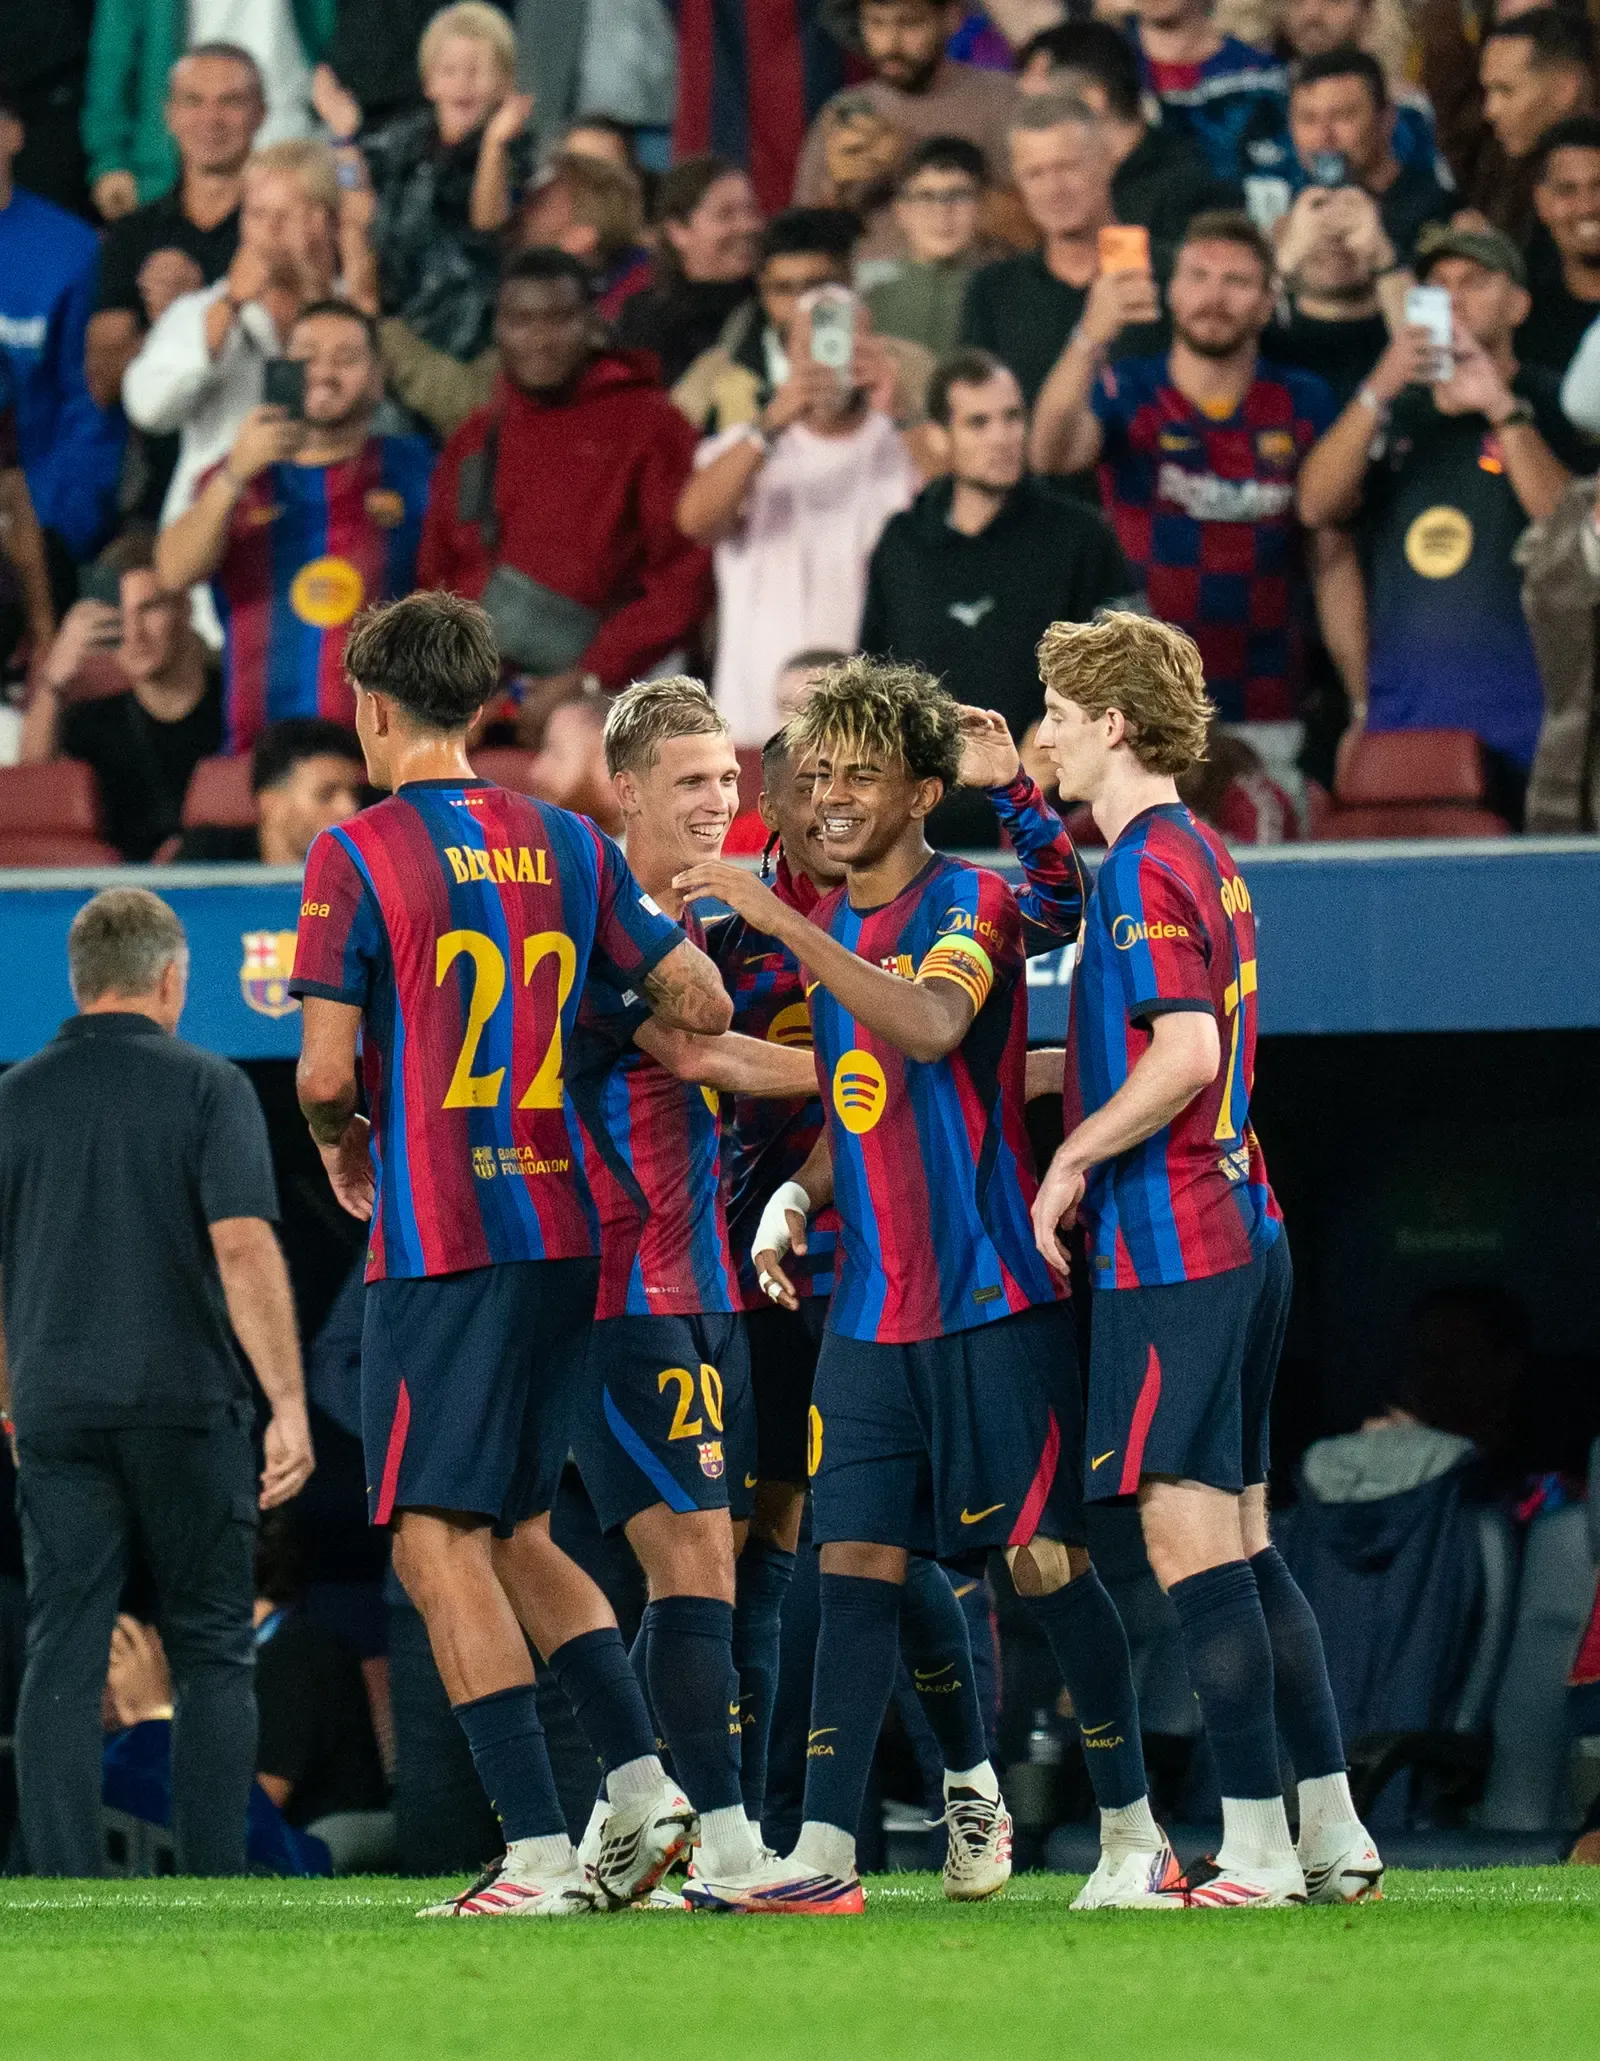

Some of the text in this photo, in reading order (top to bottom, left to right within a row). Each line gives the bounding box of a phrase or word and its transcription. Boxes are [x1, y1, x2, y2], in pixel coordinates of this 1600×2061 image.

[937, 907, 1004, 950] Midea
[1112, 914, 1189, 950] Midea
[435, 929, 576, 1109] 22
[501, 1159, 568, 1176] FOUNDATON
[658, 1363, 723, 1441] 20
[1085, 1735, 1125, 1749] BARÇA
